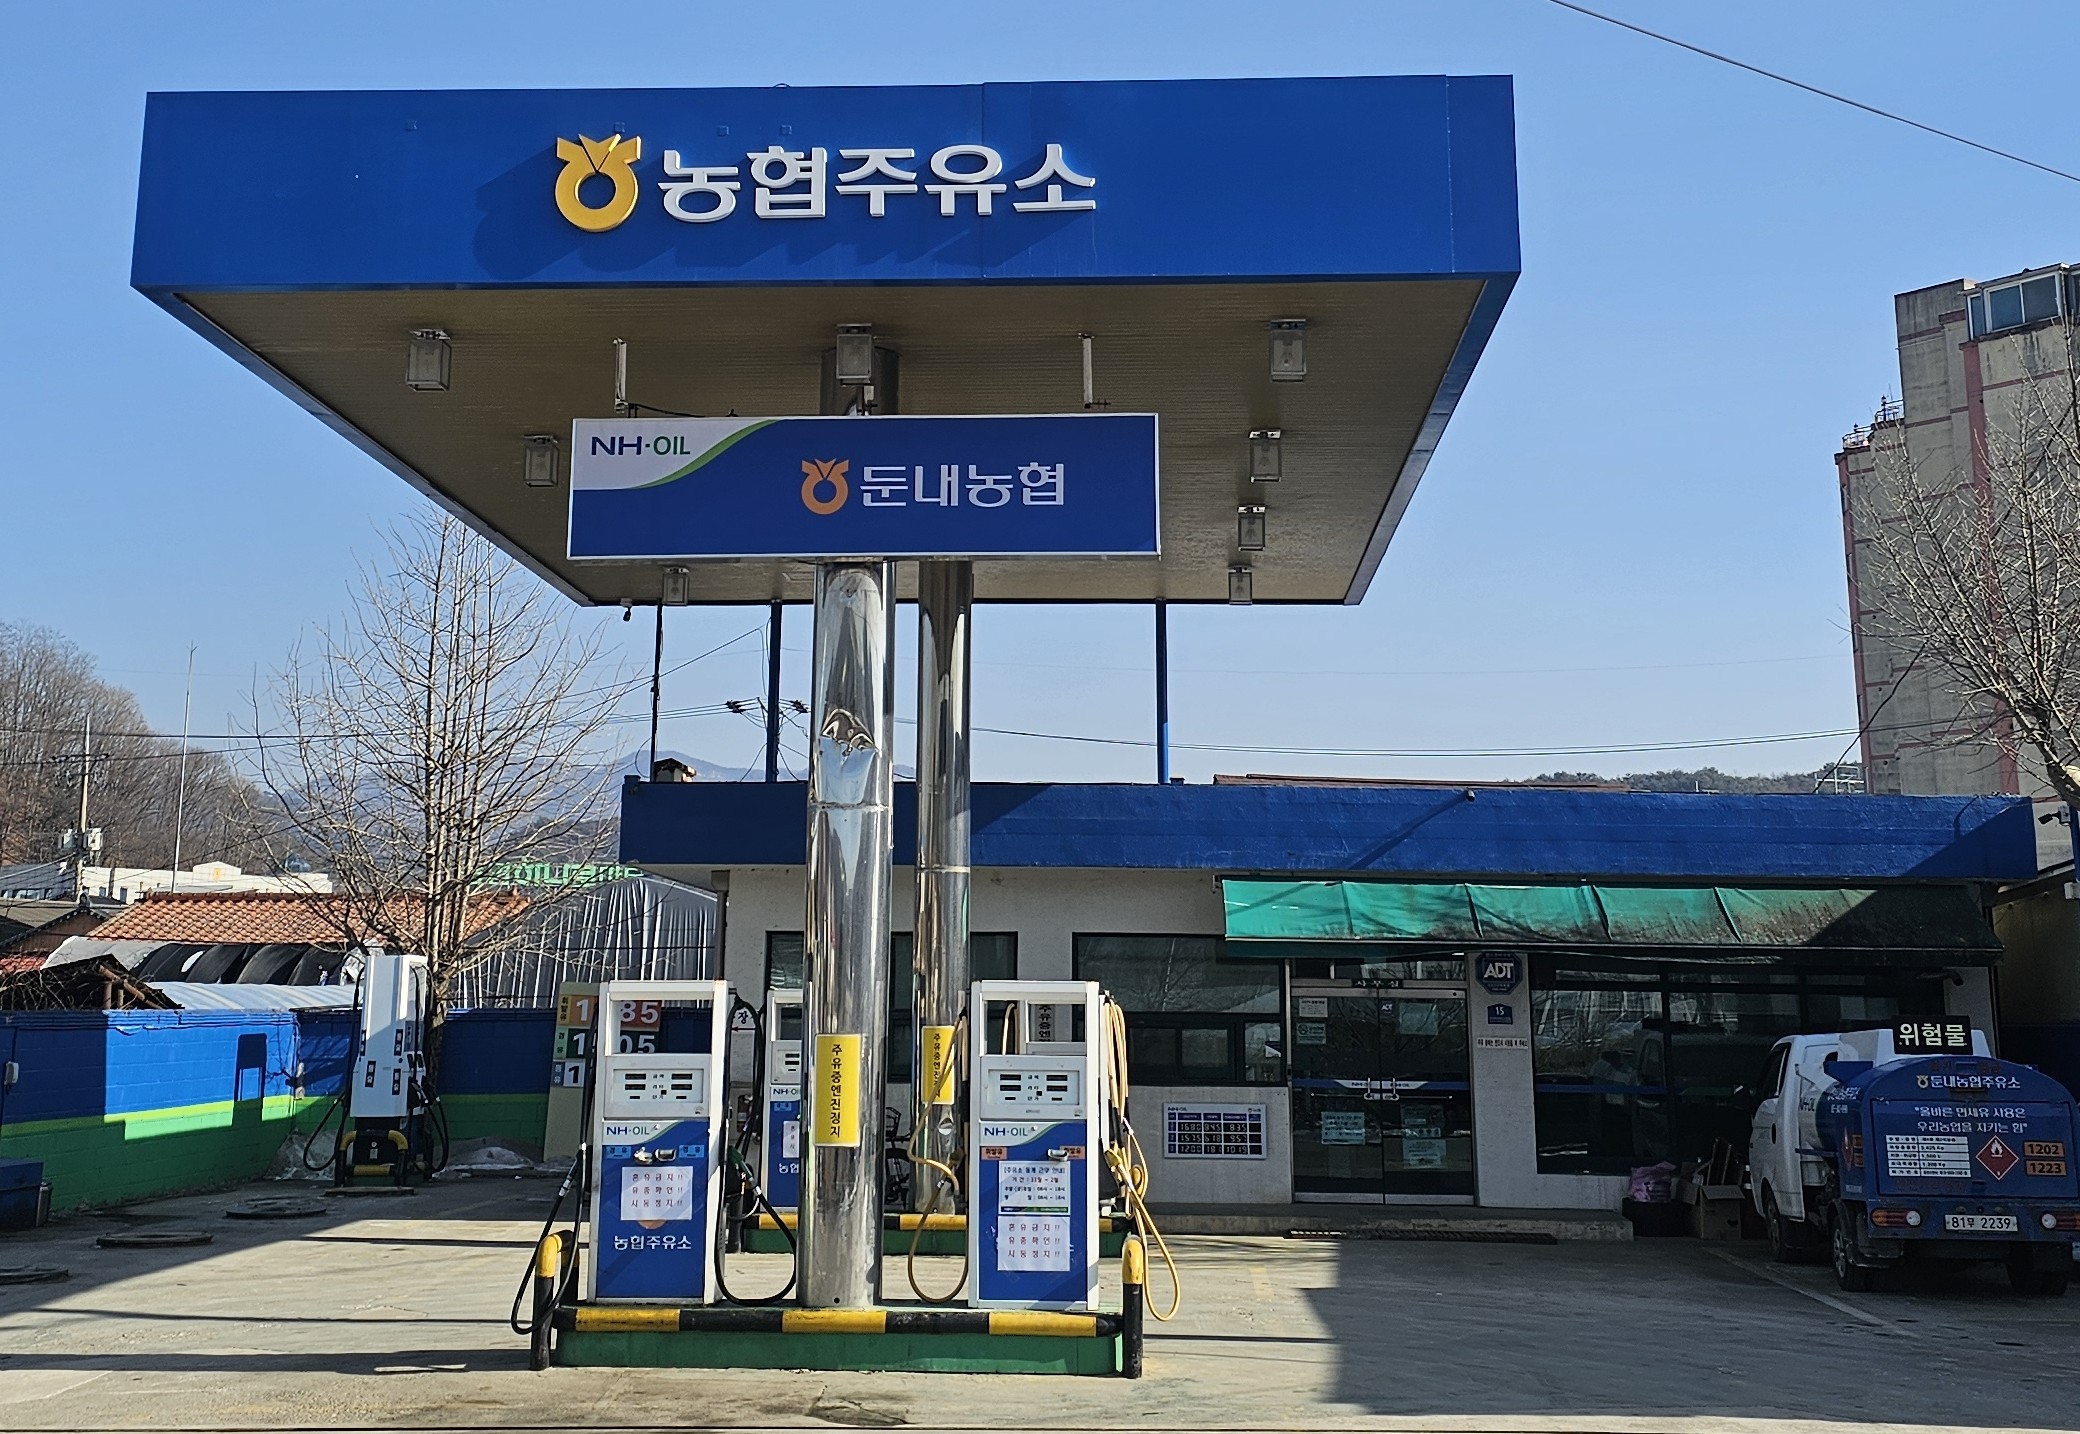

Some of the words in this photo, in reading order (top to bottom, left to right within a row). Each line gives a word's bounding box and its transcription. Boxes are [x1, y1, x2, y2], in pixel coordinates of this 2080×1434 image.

[657, 144, 1096, 222] 농협주유소
[860, 462, 1064, 507] 둔내농협
[1484, 963, 1514, 978] ADT
[1495, 1006, 1505, 1015] 15
[1900, 1023, 1967, 1047] 위험물
[1931, 1075, 2021, 1088] 둔내농협주유소
[830, 1044, 842, 1138] 주유중엔진정지
[1956, 1107, 1989, 1117] 면세유
[1993, 1107, 2026, 1118] 사용은
[1917, 1122, 1973, 1132] 우리농업을
[1977, 1122, 2009, 1133] 지키는
[2028, 1144, 2060, 1155] 1202
[2030, 1163, 2062, 1174] 1223
[1980, 1218, 2011, 1229] 2239
[614, 1235, 692, 1250] 농협주유소
